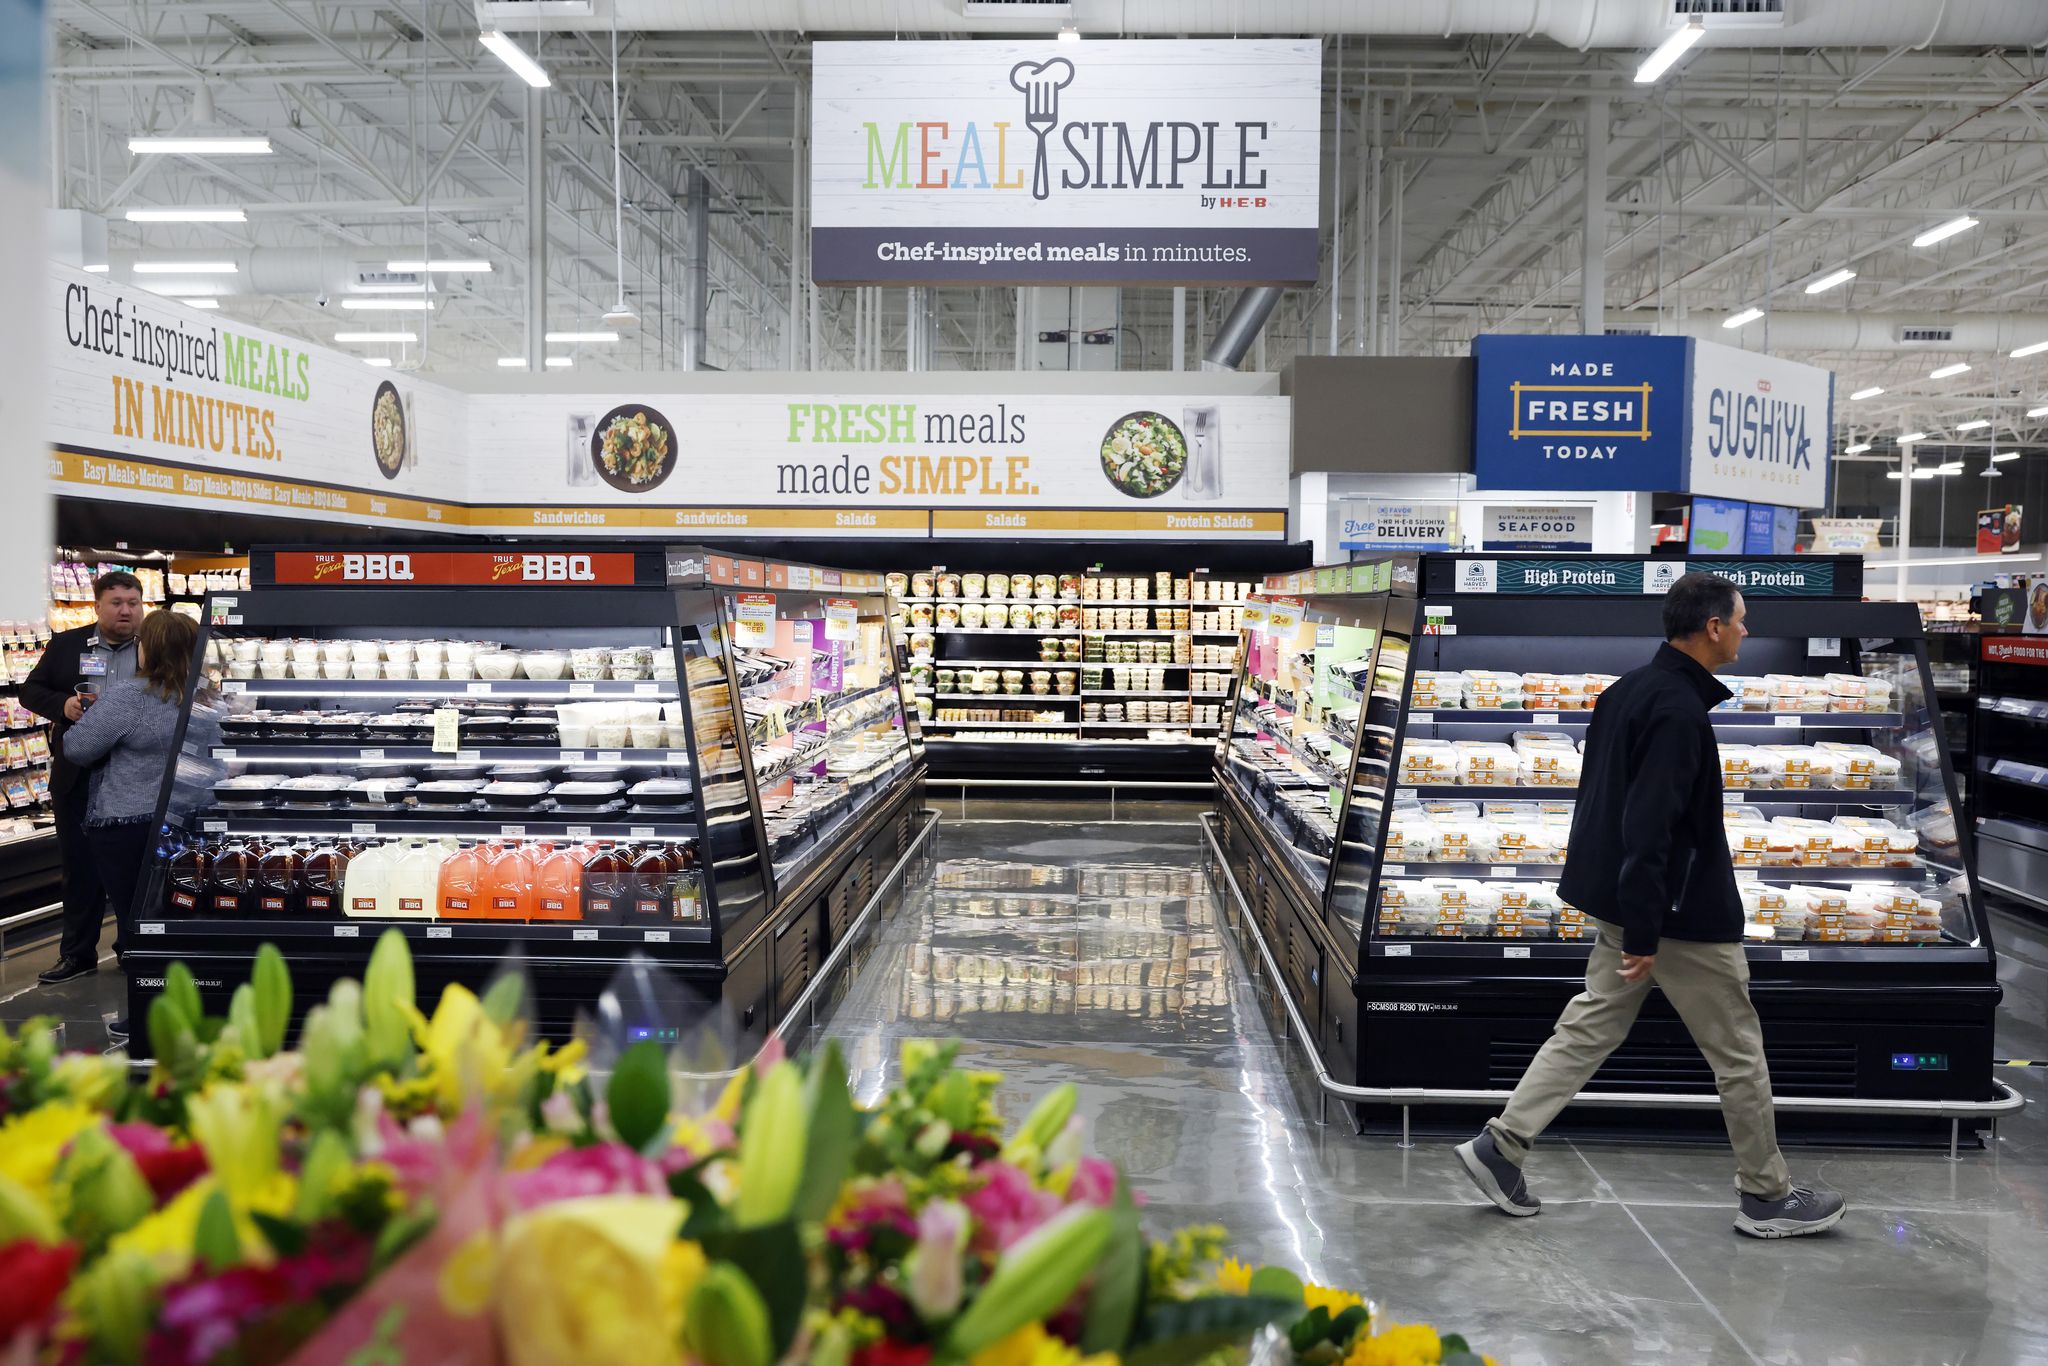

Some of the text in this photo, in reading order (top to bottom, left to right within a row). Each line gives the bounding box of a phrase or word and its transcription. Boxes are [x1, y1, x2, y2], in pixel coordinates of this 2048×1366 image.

[862, 121, 1268, 189] MEAL SIMPLE
[1201, 194, 1216, 209] by
[877, 242, 1252, 264] Chef-inspired meals in minutes.
[66, 282, 310, 402] Chef-inspired MEALS
[1550, 363, 1614, 377] MADE
[112, 375, 282, 462] IN MINUTES.
[1528, 401, 1634, 422] FRESH
[787, 404, 1026, 443] FRESH meals
[1543, 445, 1618, 460] TODAY
[83, 460, 106, 484] Easy
[777, 455, 1039, 495] made SIMPLE.
[1760, 471, 1801, 485] HOUSE
[183, 474, 203, 495] Easy
[253, 483, 273, 500] Sides
[274, 486, 291, 505] Easy
[533, 511, 606, 524] Sandwiches
[676, 511, 748, 525] Sandwiches
[835, 512, 877, 526] Salads
[985, 513, 1027, 527] Salads
[1167, 515, 1254, 528] Protein Salads
[1751, 510, 1771, 520] PARTY
[1345, 520, 1376, 534] Free
[1378, 527, 1445, 537] DELIVERY
[1499, 522, 1575, 532] SEAFOOD
[342, 555, 414, 580] BBQ
[522, 555, 595, 581] BBQ
[1524, 569, 1616, 587] High Protein
[1751, 571, 1805, 586] Protein
[213, 616, 226, 625] A1
[1423, 625, 1439, 635] A1
[177, 896, 193, 907] BBQ
[311, 899, 328, 907] BBQ
[451, 901, 468, 909] BBQ
[499, 900, 515, 908] BBQ
[547, 901, 562, 909] BBQ
[593, 902, 609, 910] BBQ
[1400, 1003, 1416, 1011] R290
